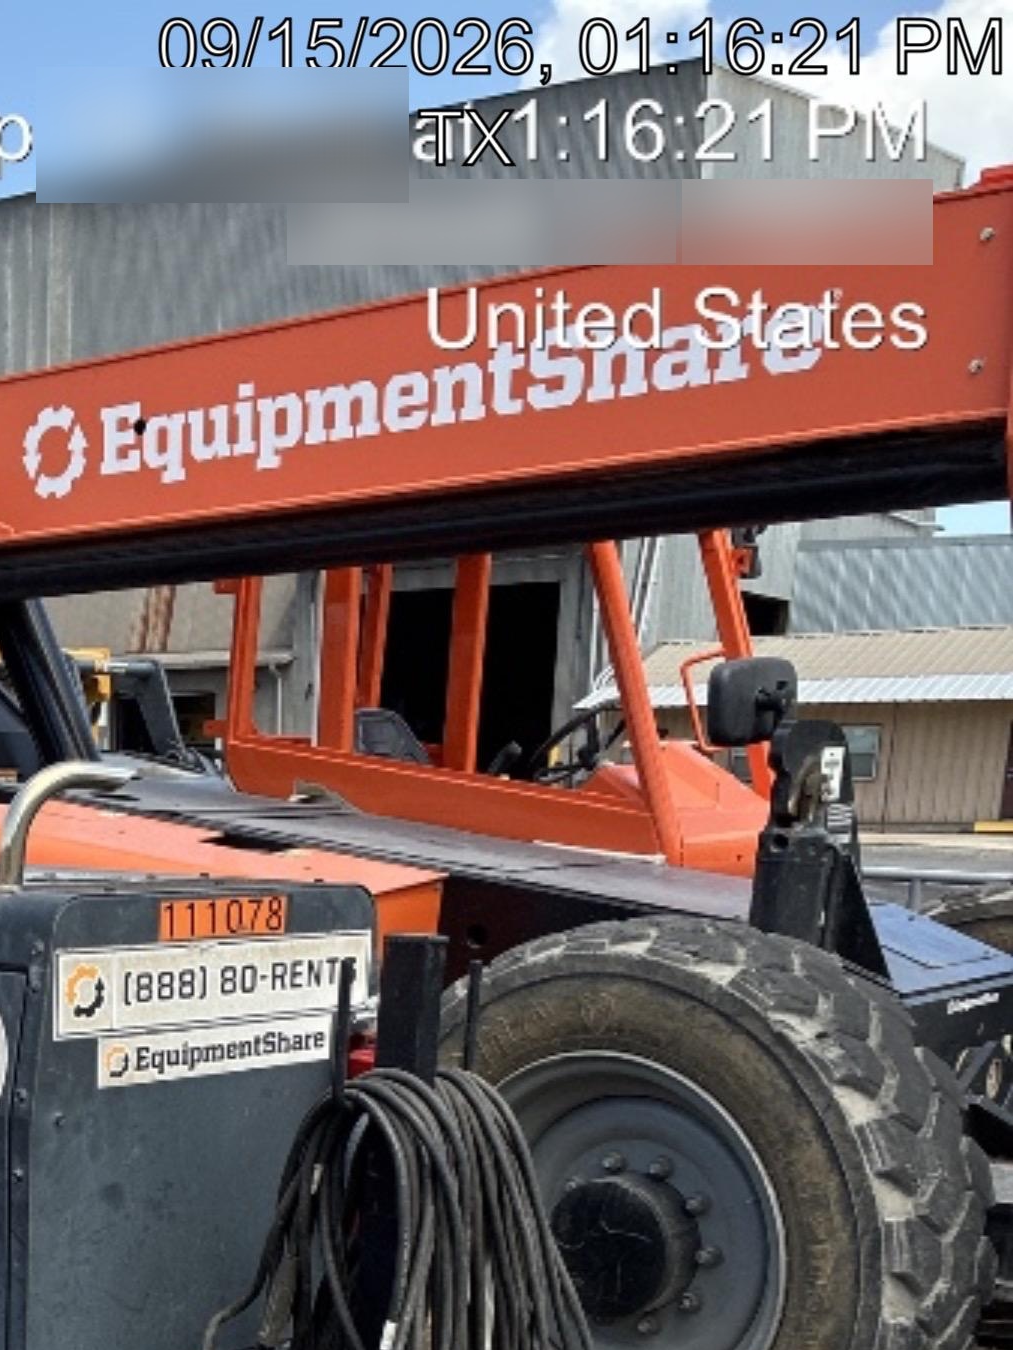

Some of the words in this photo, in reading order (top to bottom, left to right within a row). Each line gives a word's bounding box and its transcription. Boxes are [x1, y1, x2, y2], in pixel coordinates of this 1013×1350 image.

[163, 896, 285, 938] 111078
[123, 965, 209, 1006] (888)
[133, 1030, 325, 1074] EquipmentShare
